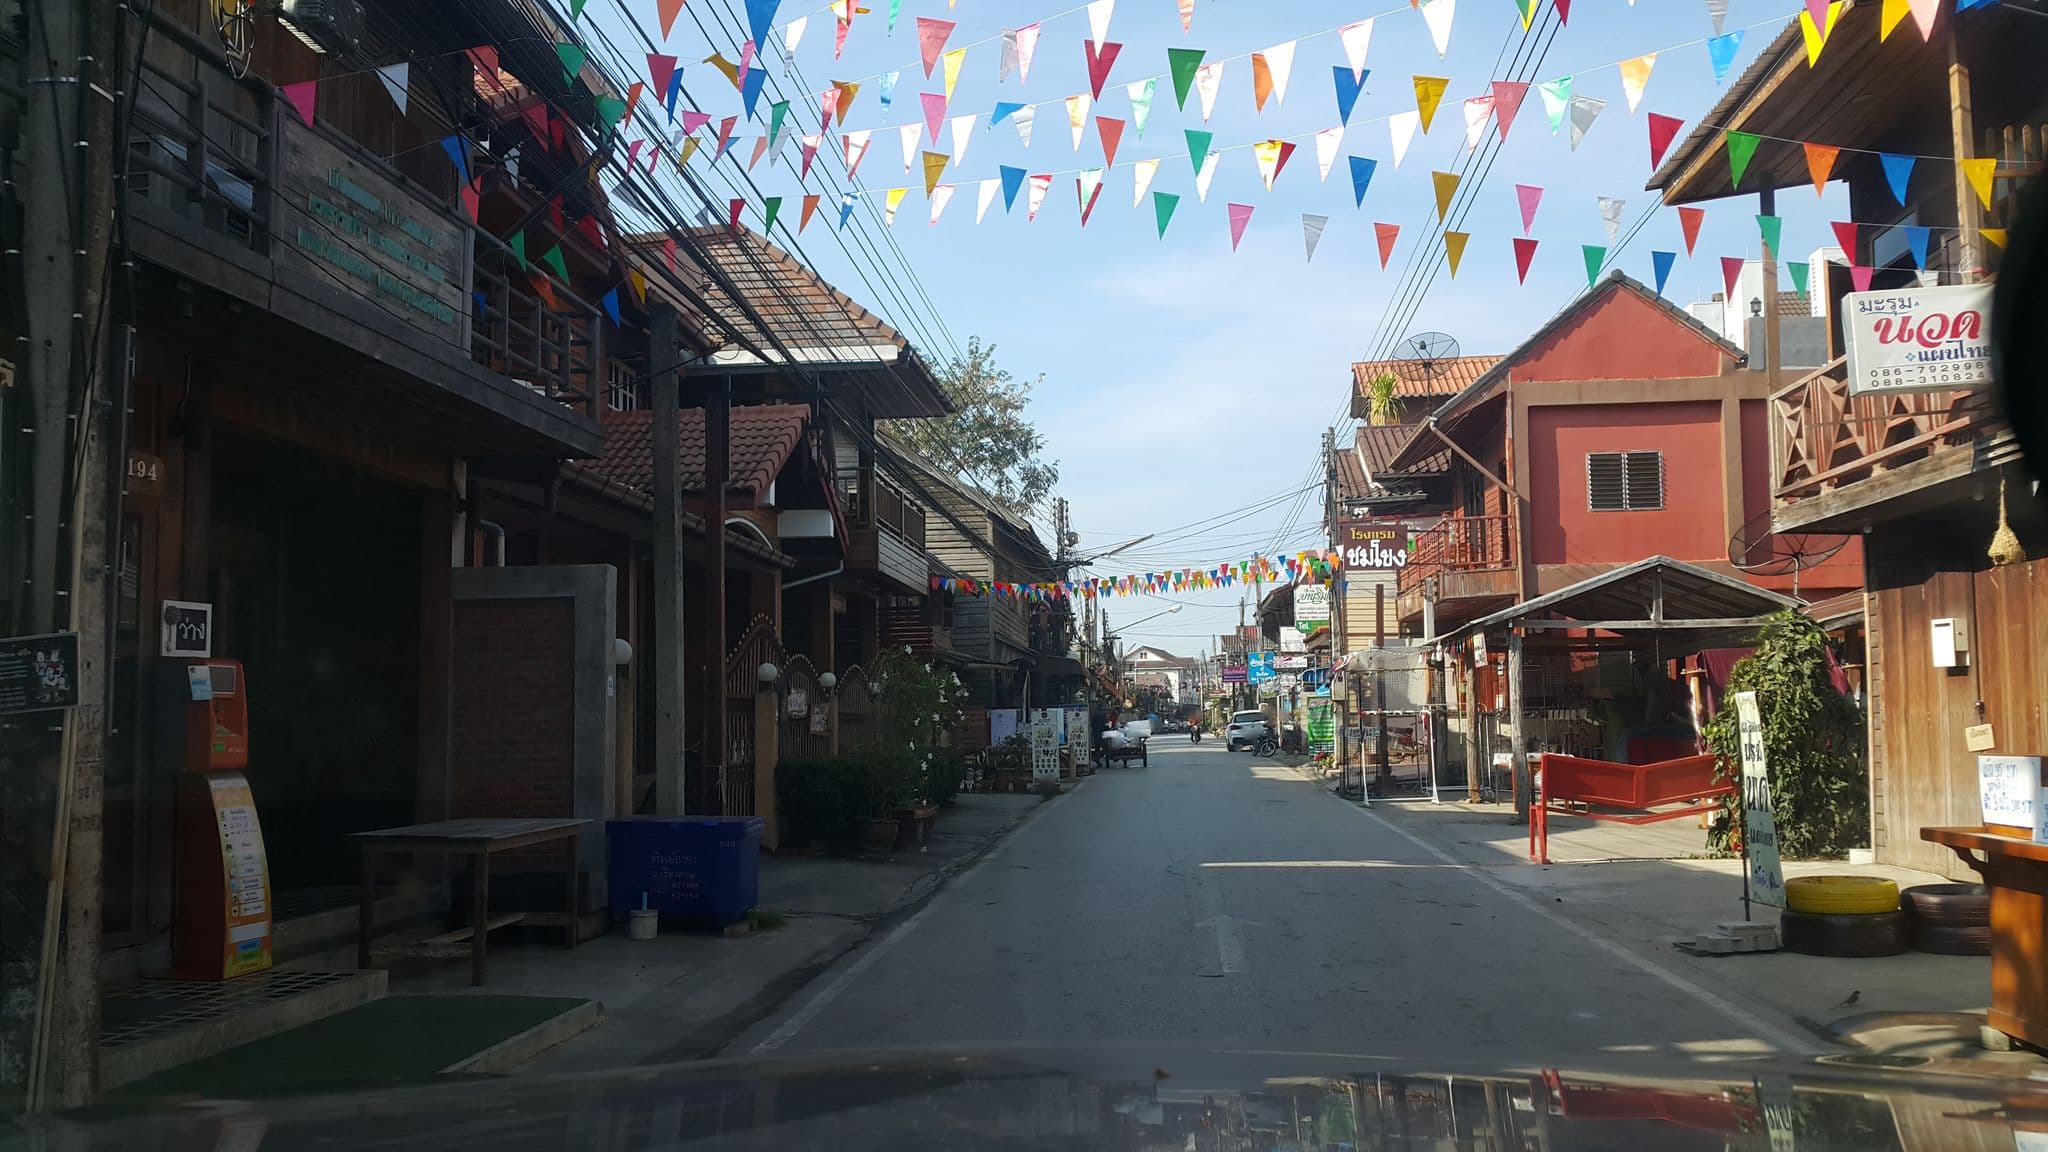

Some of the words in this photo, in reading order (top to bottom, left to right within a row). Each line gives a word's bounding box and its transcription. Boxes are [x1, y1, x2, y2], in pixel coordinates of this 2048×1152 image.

[1859, 296, 1912, 316] มะรุม
[1873, 310, 1982, 349] นวด
[1870, 361, 1986, 378] 086-792998
[1871, 371, 1985, 388] 088-310824
[127, 458, 158, 481] 194
[1350, 527, 1397, 540] โรงแรม
[1346, 539, 1408, 568] ชมโขง
[178, 615, 206, 641] ว่าง
